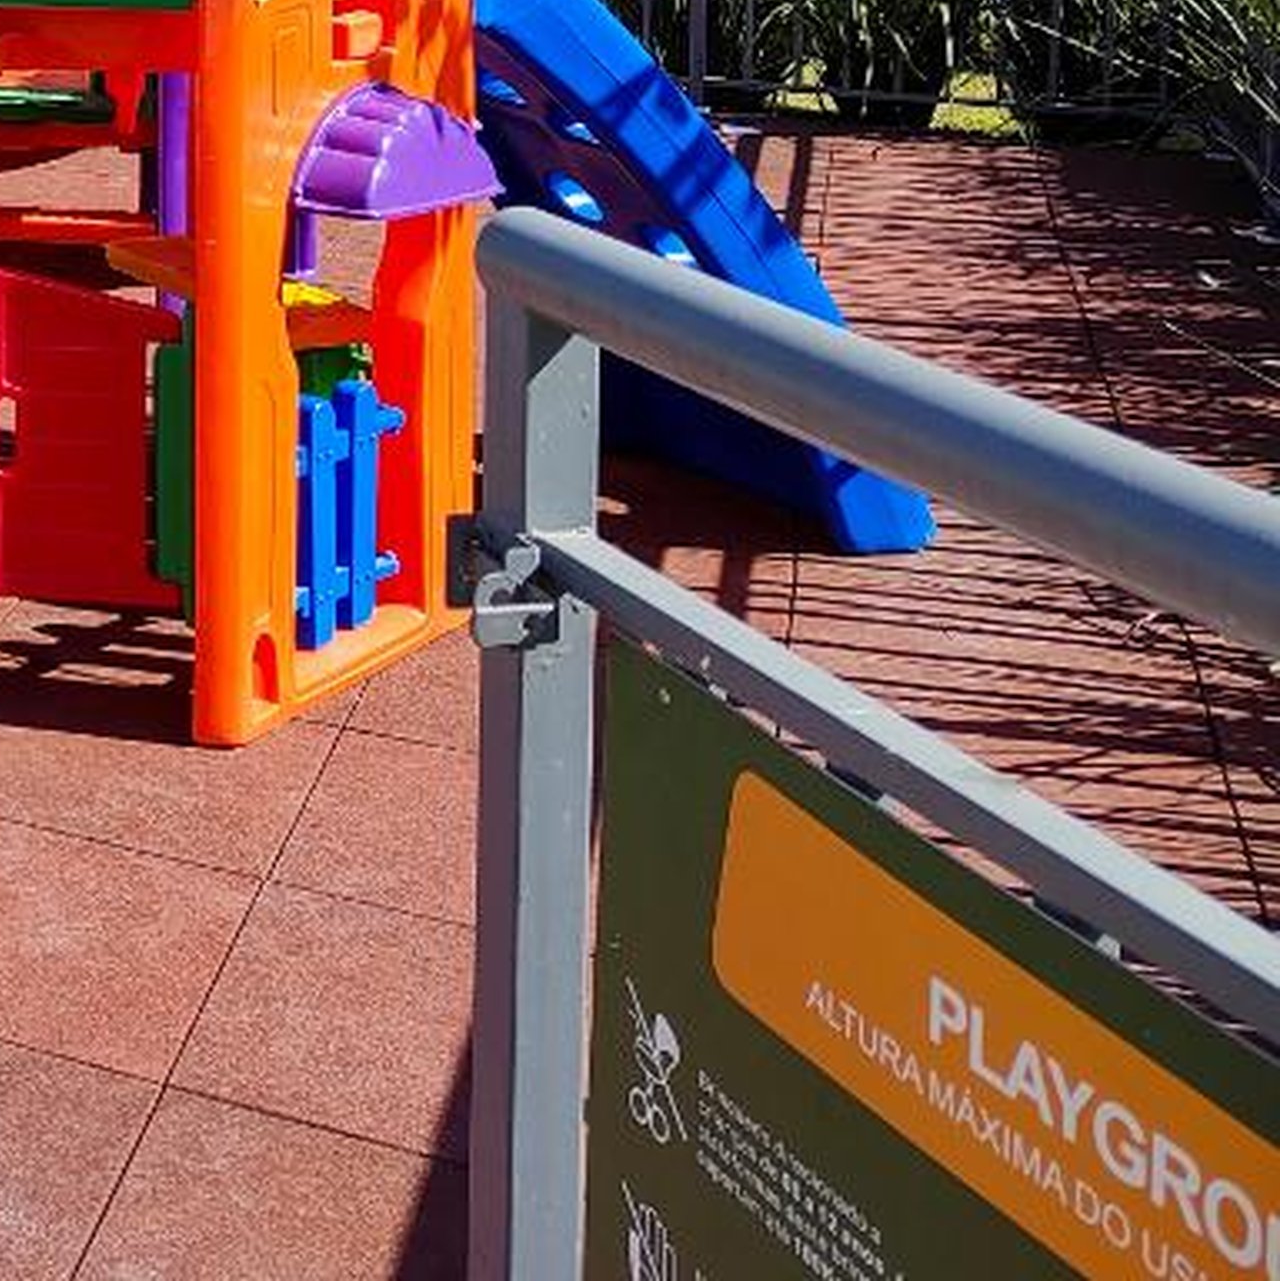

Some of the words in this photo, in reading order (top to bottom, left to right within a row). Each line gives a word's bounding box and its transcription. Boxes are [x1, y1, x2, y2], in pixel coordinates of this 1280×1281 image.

[805, 981, 924, 1096] ALTURA
[928, 1069, 1069, 1209] MÁXIMA
[1075, 1178, 1132, 1249] DO
[929, 975, 1280, 1281] PLAYGRO
